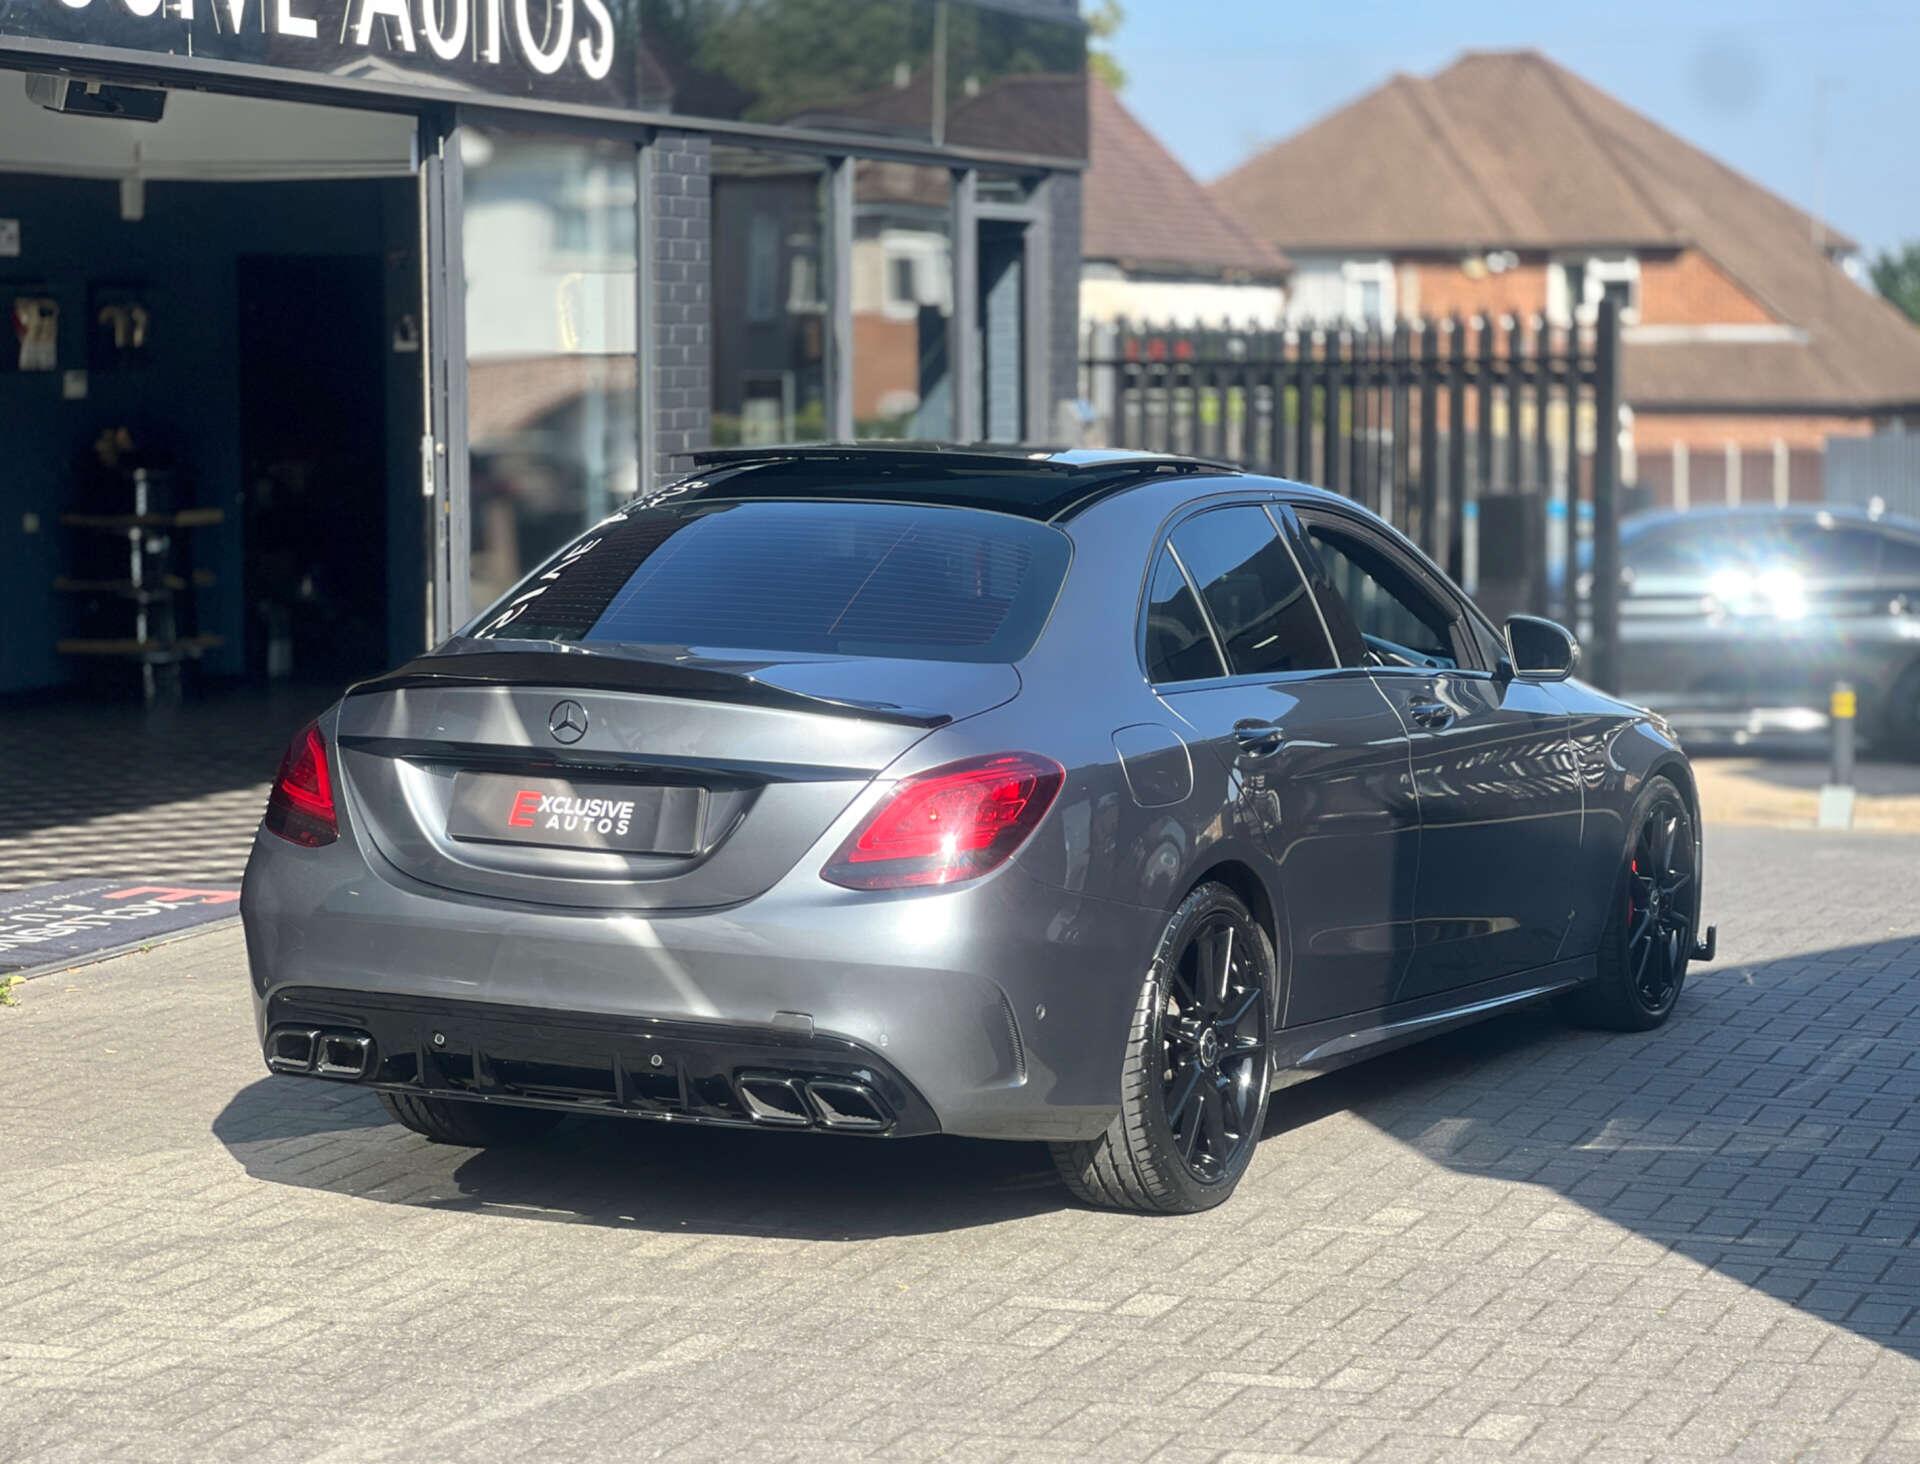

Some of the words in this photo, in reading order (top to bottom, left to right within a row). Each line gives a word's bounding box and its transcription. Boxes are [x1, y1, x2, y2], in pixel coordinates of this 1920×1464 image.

[509, 790, 635, 827] EXCLUSIVE
[545, 815, 630, 836] AUTOS
[0, 886, 240, 952] EXCLUSI
